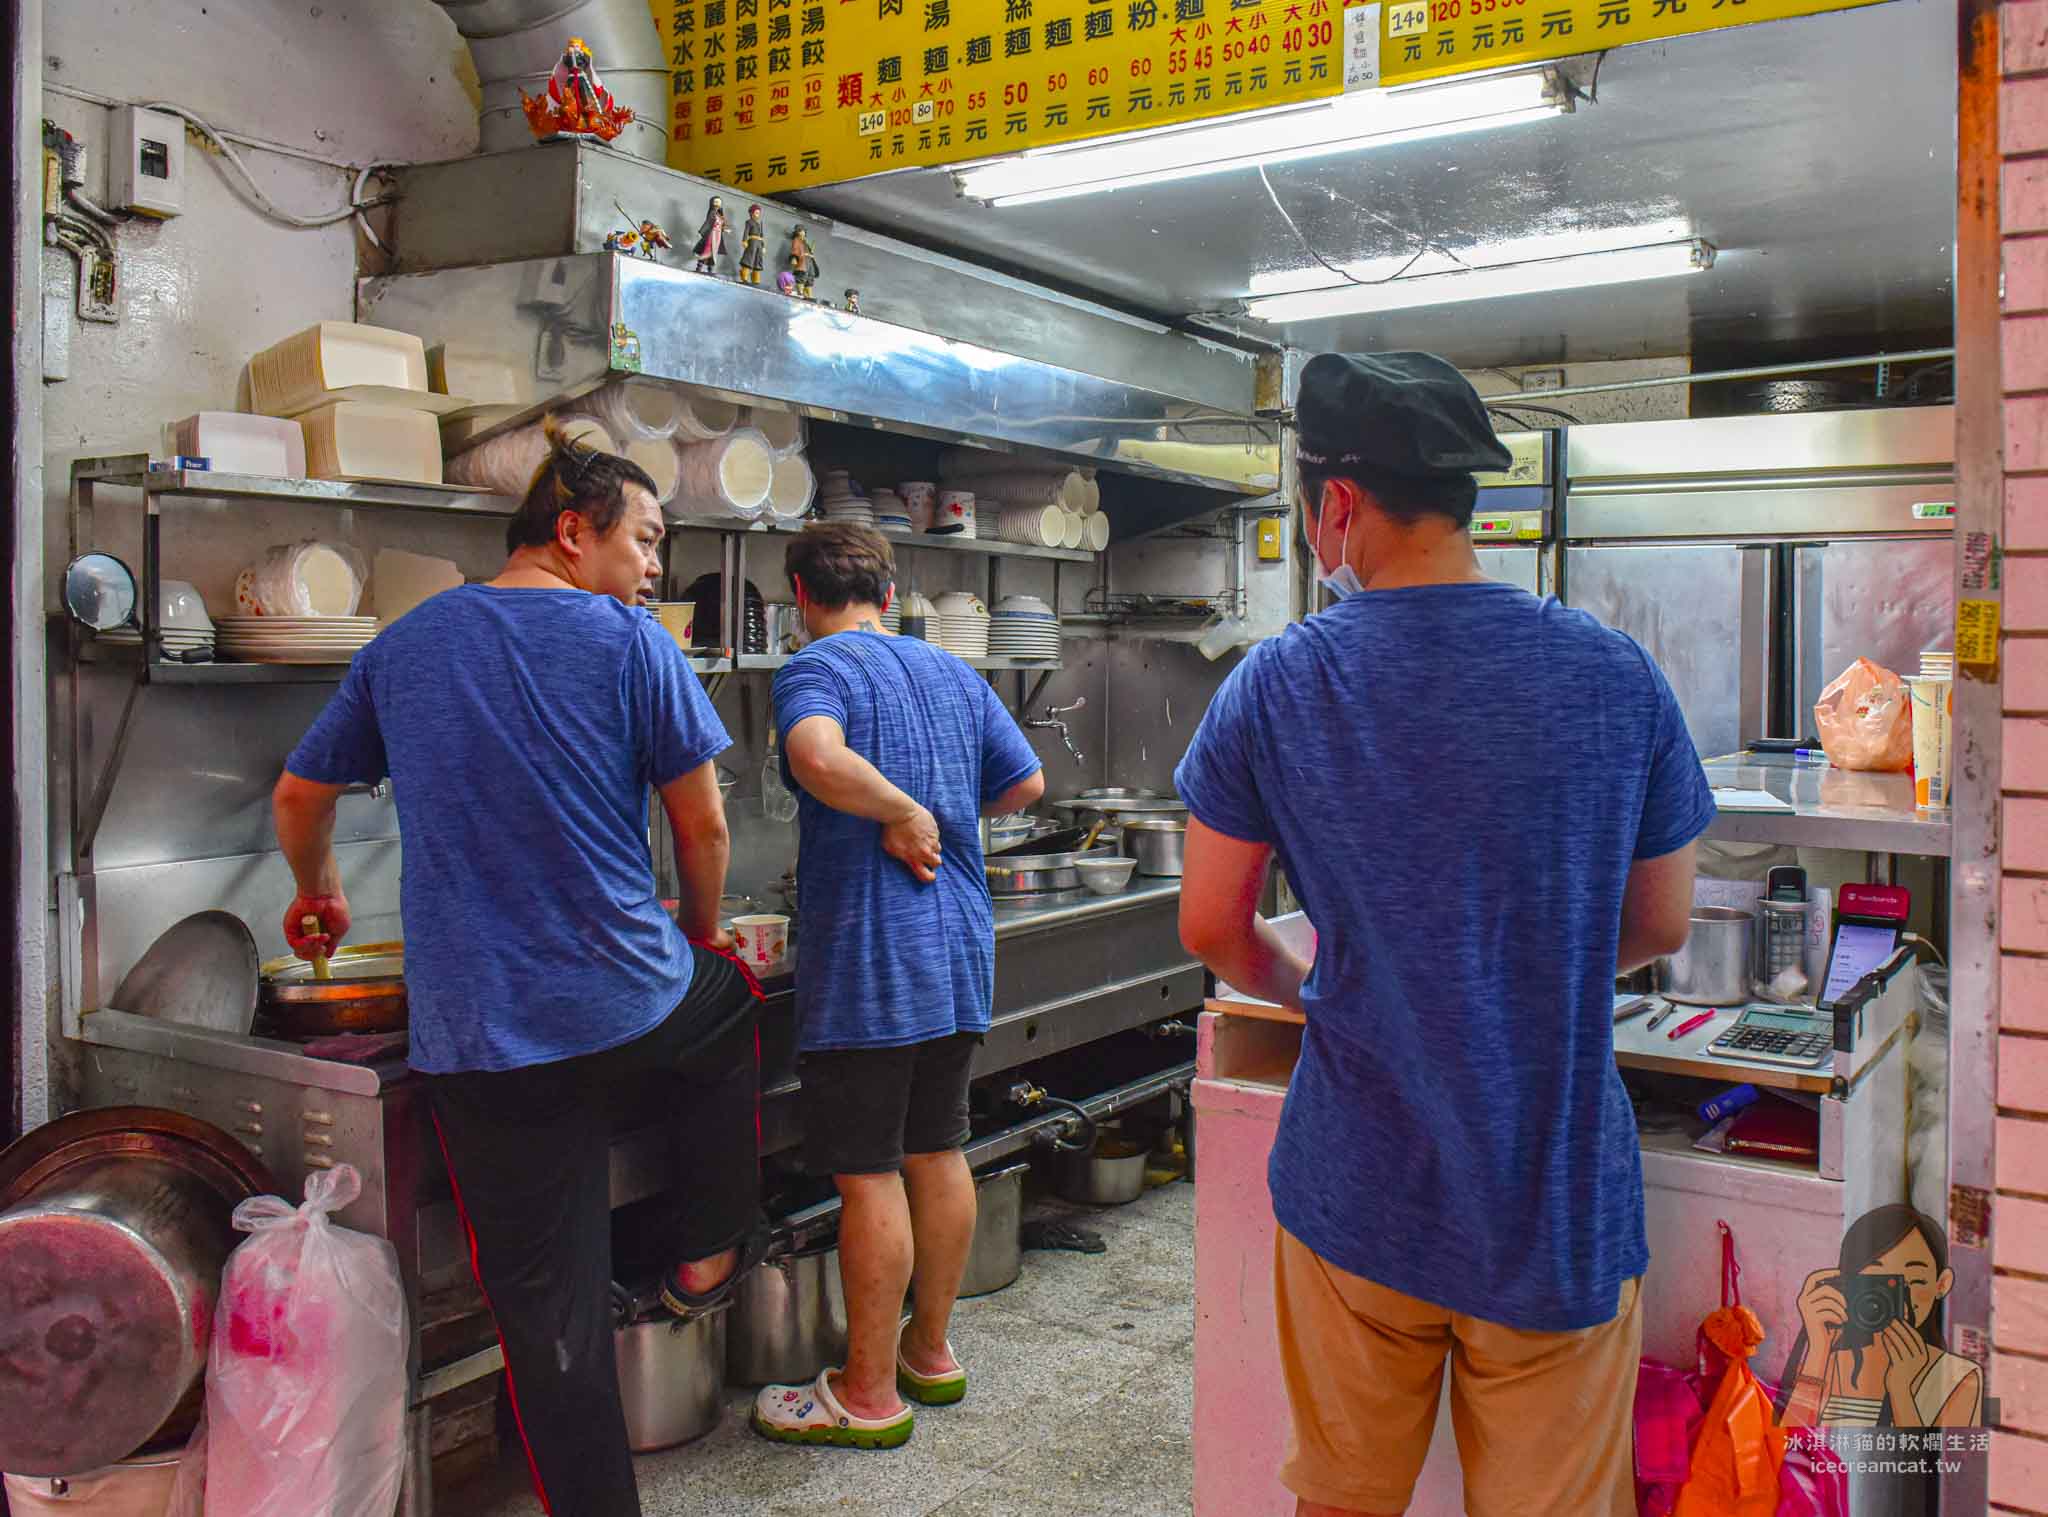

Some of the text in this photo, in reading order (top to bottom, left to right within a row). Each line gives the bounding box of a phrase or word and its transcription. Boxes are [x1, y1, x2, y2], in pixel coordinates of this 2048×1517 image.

[1225, 11, 1268, 36] 大 小
[1283, 3, 1303, 24] 大
[1391, 10, 1425, 31] 140
[1431, 0, 1461, 22] 120
[800, 0, 825, 68] 湯餃
[1044, 17, 1073, 50] 麵
[1169, 21, 1213, 46] 大 小
[1282, 27, 1303, 53] 40
[1307, 20, 1333, 49] 30
[1404, 36, 1422, 62] 元
[1437, 30, 1455, 57] 元
[1472, 24, 1495, 51] 元
[1502, 18, 1524, 46] 元
[1541, 9, 1573, 39] 元
[1597, 0, 1631, 29] 元
[672, 0, 695, 96] 菜水餃
[965, 35, 993, 67] 麵
[1168, 45, 1213, 75] 55 45
[1223, 34, 1271, 62] 50 40
[1087, 67, 1109, 86] 60
[1130, 57, 1151, 77] 60
[1283, 54, 1329, 85] 元 元
[837, 72, 864, 109] 類
[1004, 81, 1029, 106] 50
[1047, 73, 1068, 92] 50
[1168, 77, 1211, 107] 元 元
[1225, 66, 1268, 97] 元 元
[917, 100, 955, 118] 80 70
[968, 91, 987, 110] 55
[1086, 96, 1111, 121] 元
[1128, 88, 1153, 113] 元
[860, 108, 912, 132] 140 120
[1004, 111, 1028, 136] 元
[1044, 103, 1069, 128] 元
[918, 125, 951, 152] 元 元
[965, 119, 987, 143] 元
[869, 133, 905, 160] 元 元
[735, 162, 753, 184] 元
[768, 155, 787, 178] 元
[800, 150, 820, 172] 元
